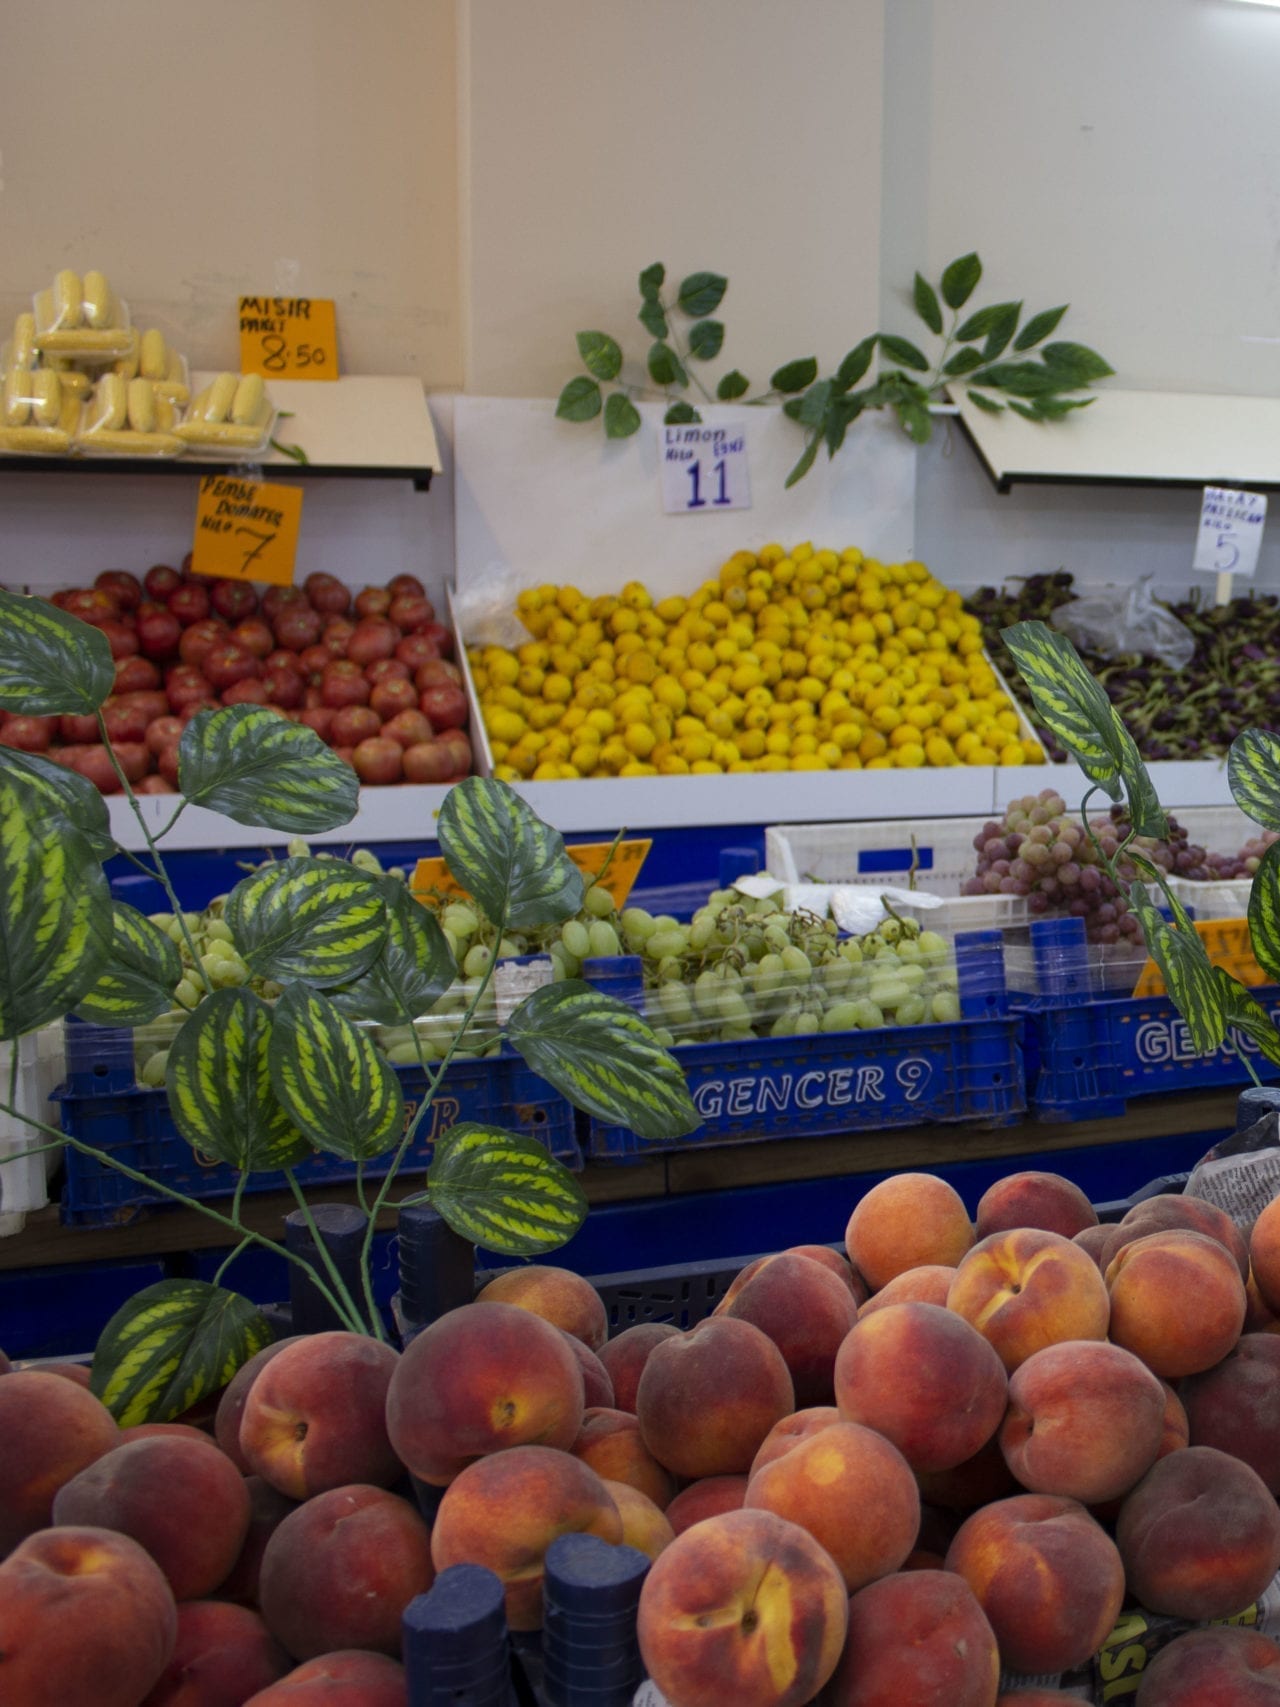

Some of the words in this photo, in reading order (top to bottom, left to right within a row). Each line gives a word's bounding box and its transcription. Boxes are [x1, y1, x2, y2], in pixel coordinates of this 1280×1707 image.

[666, 428, 726, 443] Limon
[687, 459, 732, 508] 11
[235, 526, 276, 573] 7
[1214, 533, 1240, 569] 5
[692, 1066, 886, 1119] GENCER
